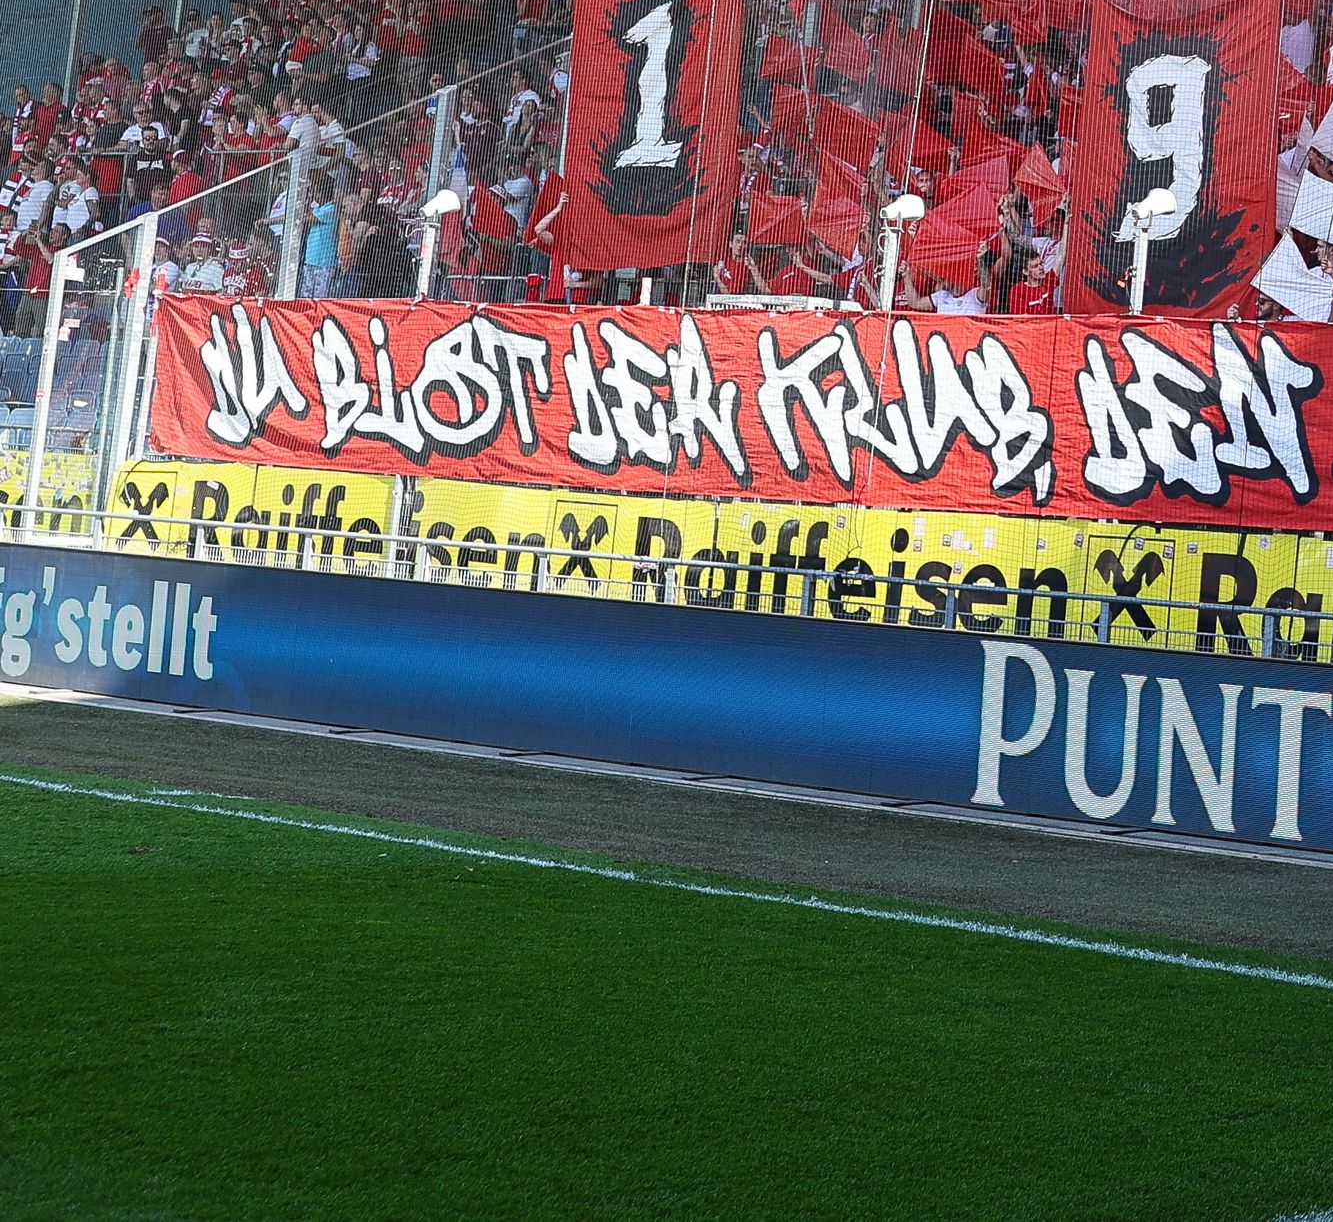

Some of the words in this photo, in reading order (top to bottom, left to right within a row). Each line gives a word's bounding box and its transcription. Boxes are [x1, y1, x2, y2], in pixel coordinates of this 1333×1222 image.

[614, 0, 683, 169] 1
[1115, 53, 1212, 243] 9
[562, 312, 755, 489] DER
[1075, 324, 1322, 506] DEN
[632, 514, 1069, 643] Raiffeisen
